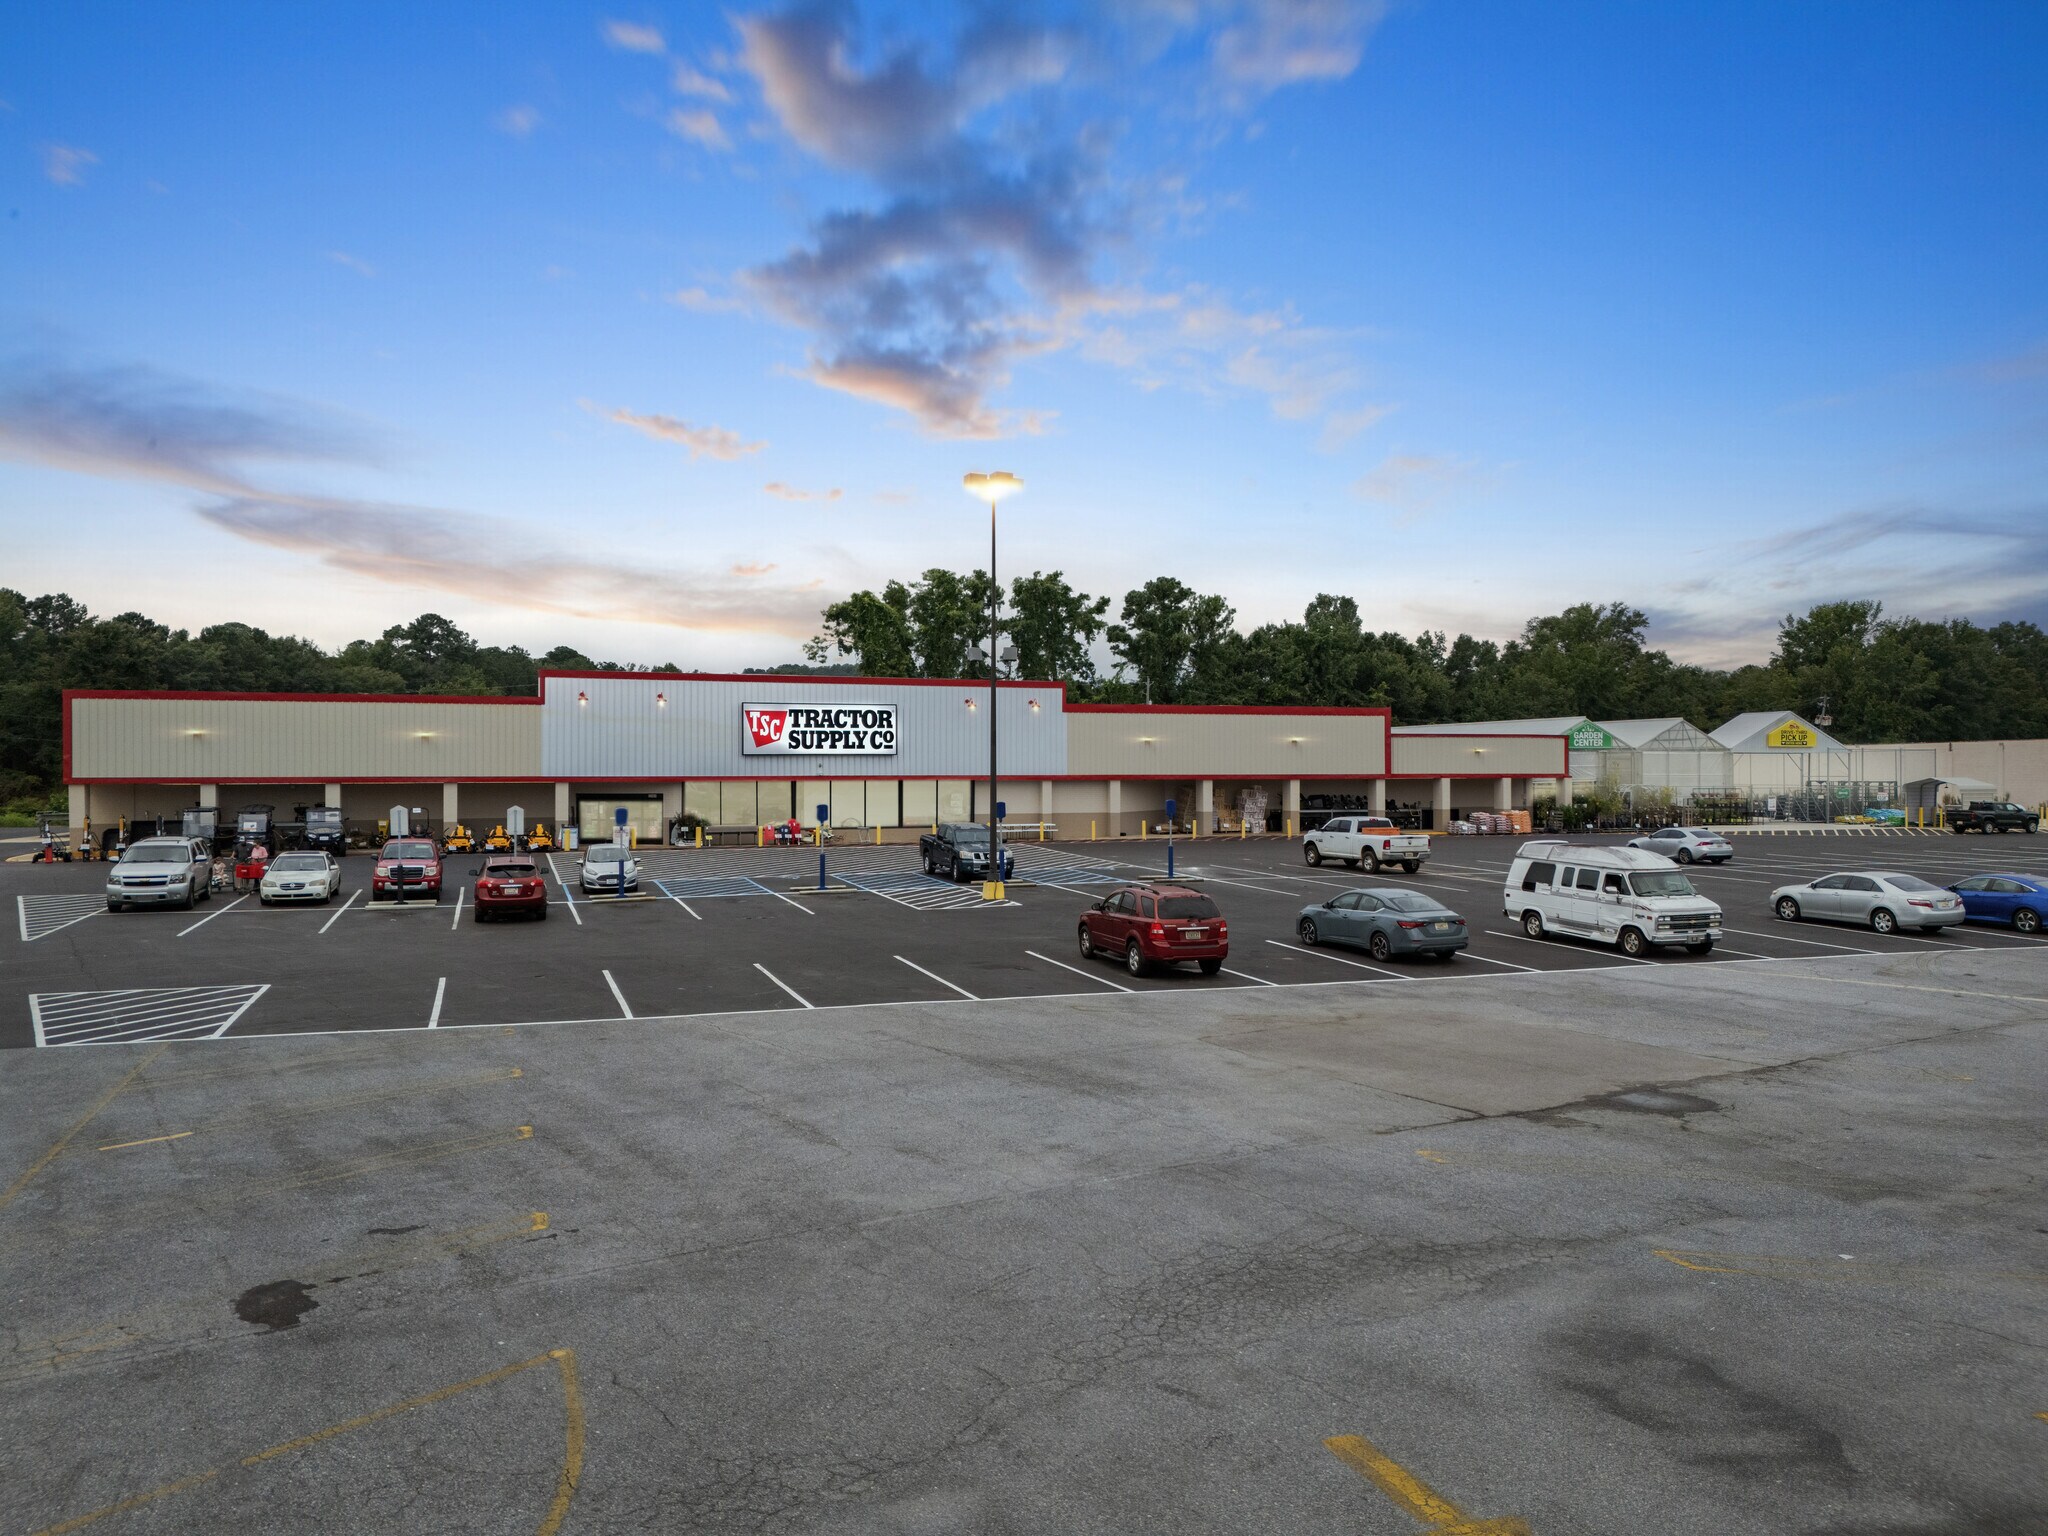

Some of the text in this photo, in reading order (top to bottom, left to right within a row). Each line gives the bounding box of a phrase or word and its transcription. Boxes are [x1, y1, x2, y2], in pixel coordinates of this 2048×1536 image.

[750, 711, 781, 741] TSC
[788, 709, 893, 728] TRACTOR
[788, 730, 868, 749] SUPPLY
